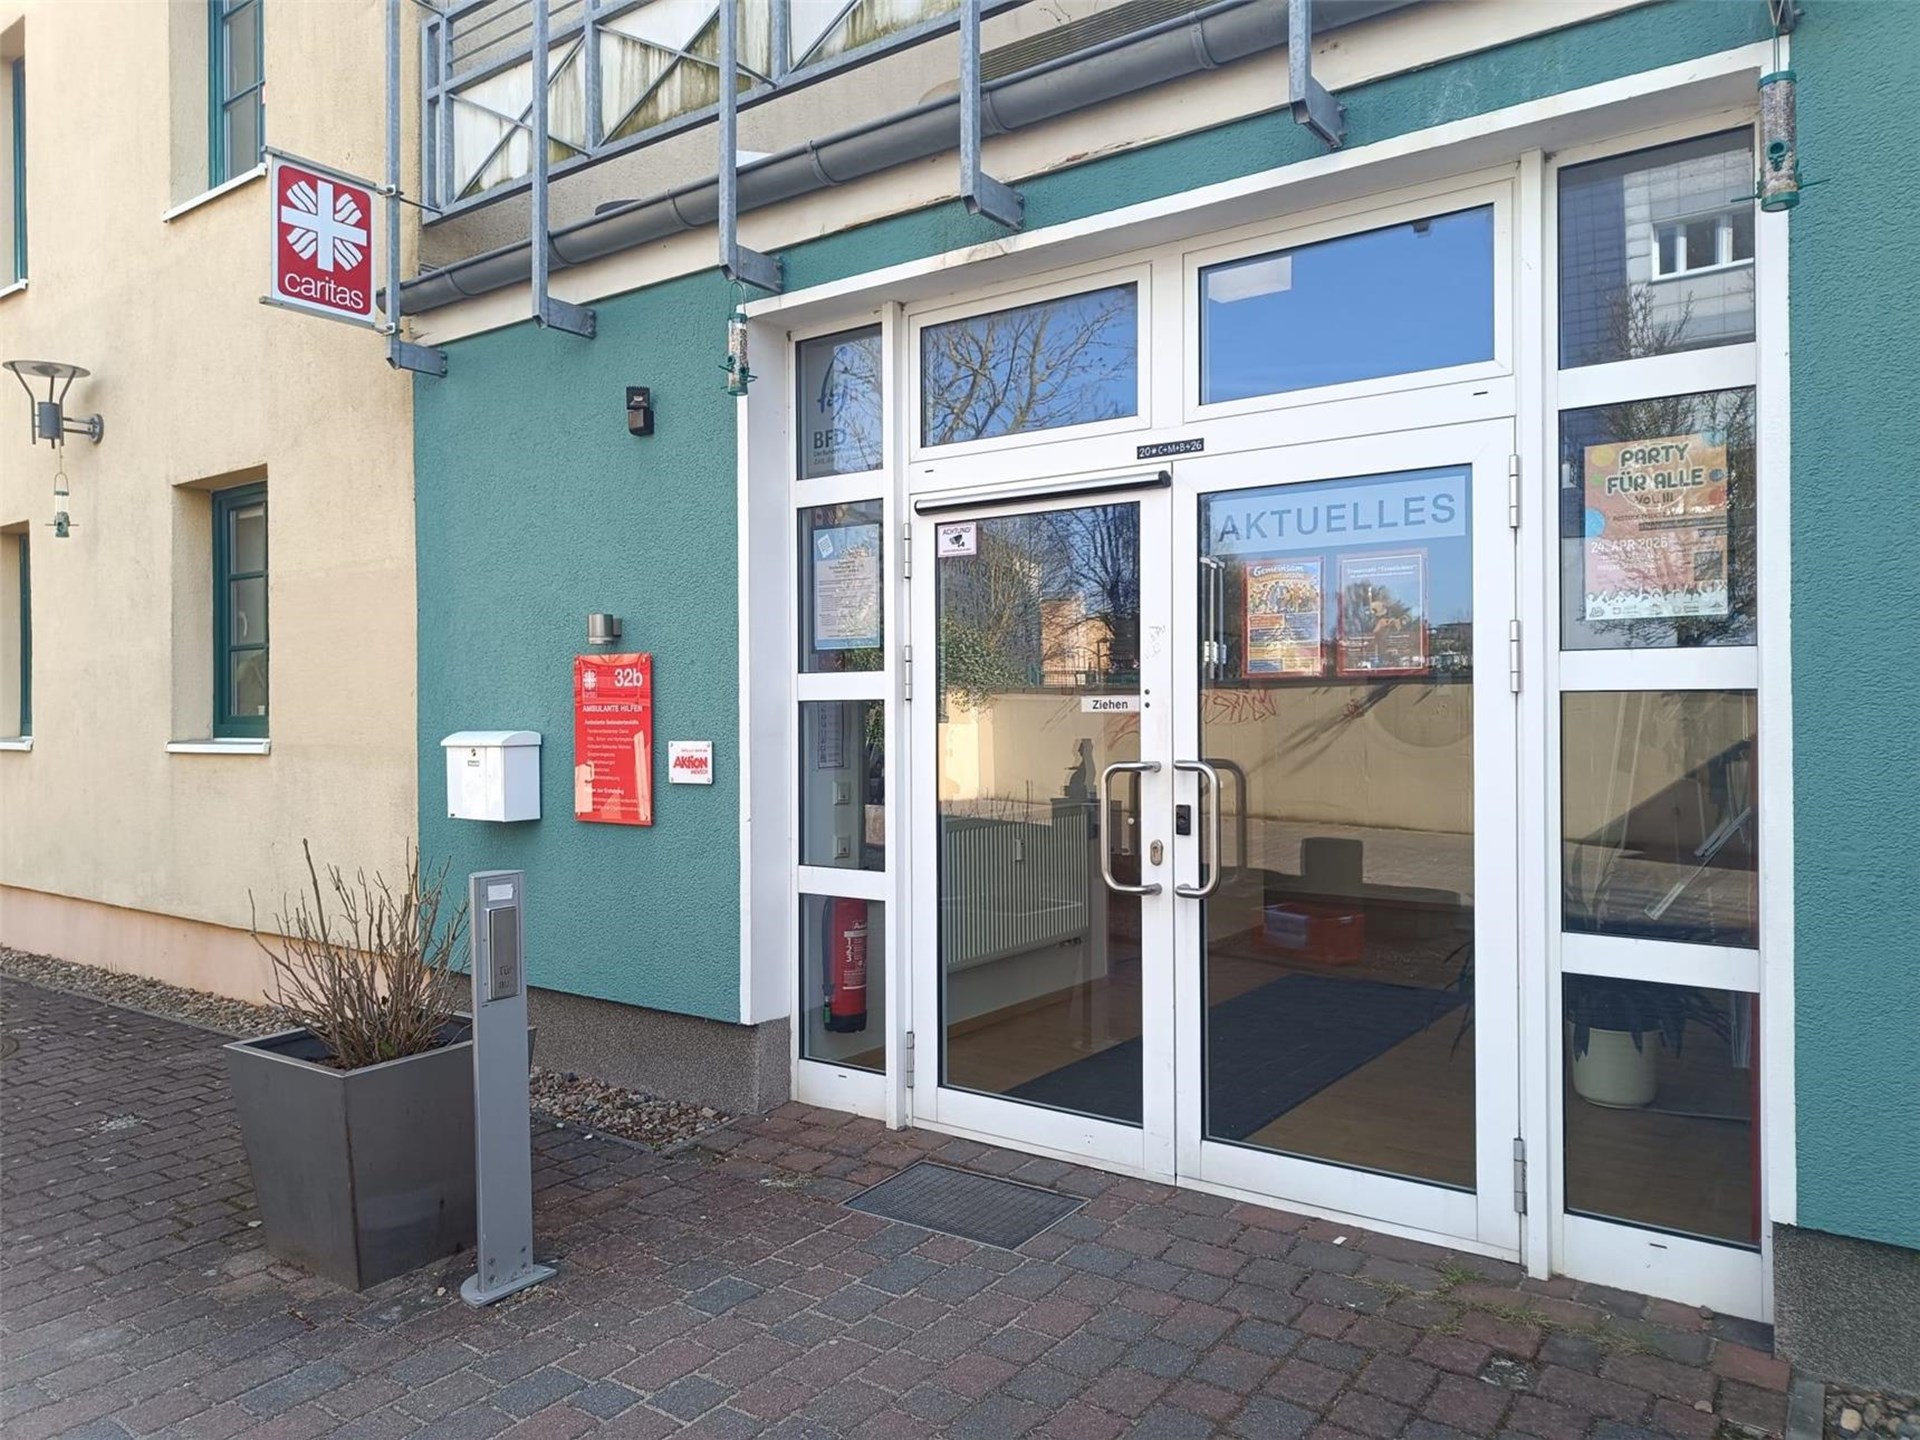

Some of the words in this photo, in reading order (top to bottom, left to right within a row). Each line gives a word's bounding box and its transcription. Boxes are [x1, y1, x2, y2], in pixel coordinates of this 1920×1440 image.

[284, 272, 364, 309] caritas
[814, 428, 847, 449] BFD
[1620, 443, 1689, 467] PARTY
[1607, 471, 1647, 494] FÜR
[1654, 468, 1704, 489] ALLE
[1662, 492, 1674, 503] III
[1218, 493, 1456, 542] AKTUELLES
[614, 668, 643, 687] 32b
[582, 705, 619, 713] AMBULANTE
[620, 704, 643, 713] HILFEN
[1092, 699, 1128, 709] Ziehen
